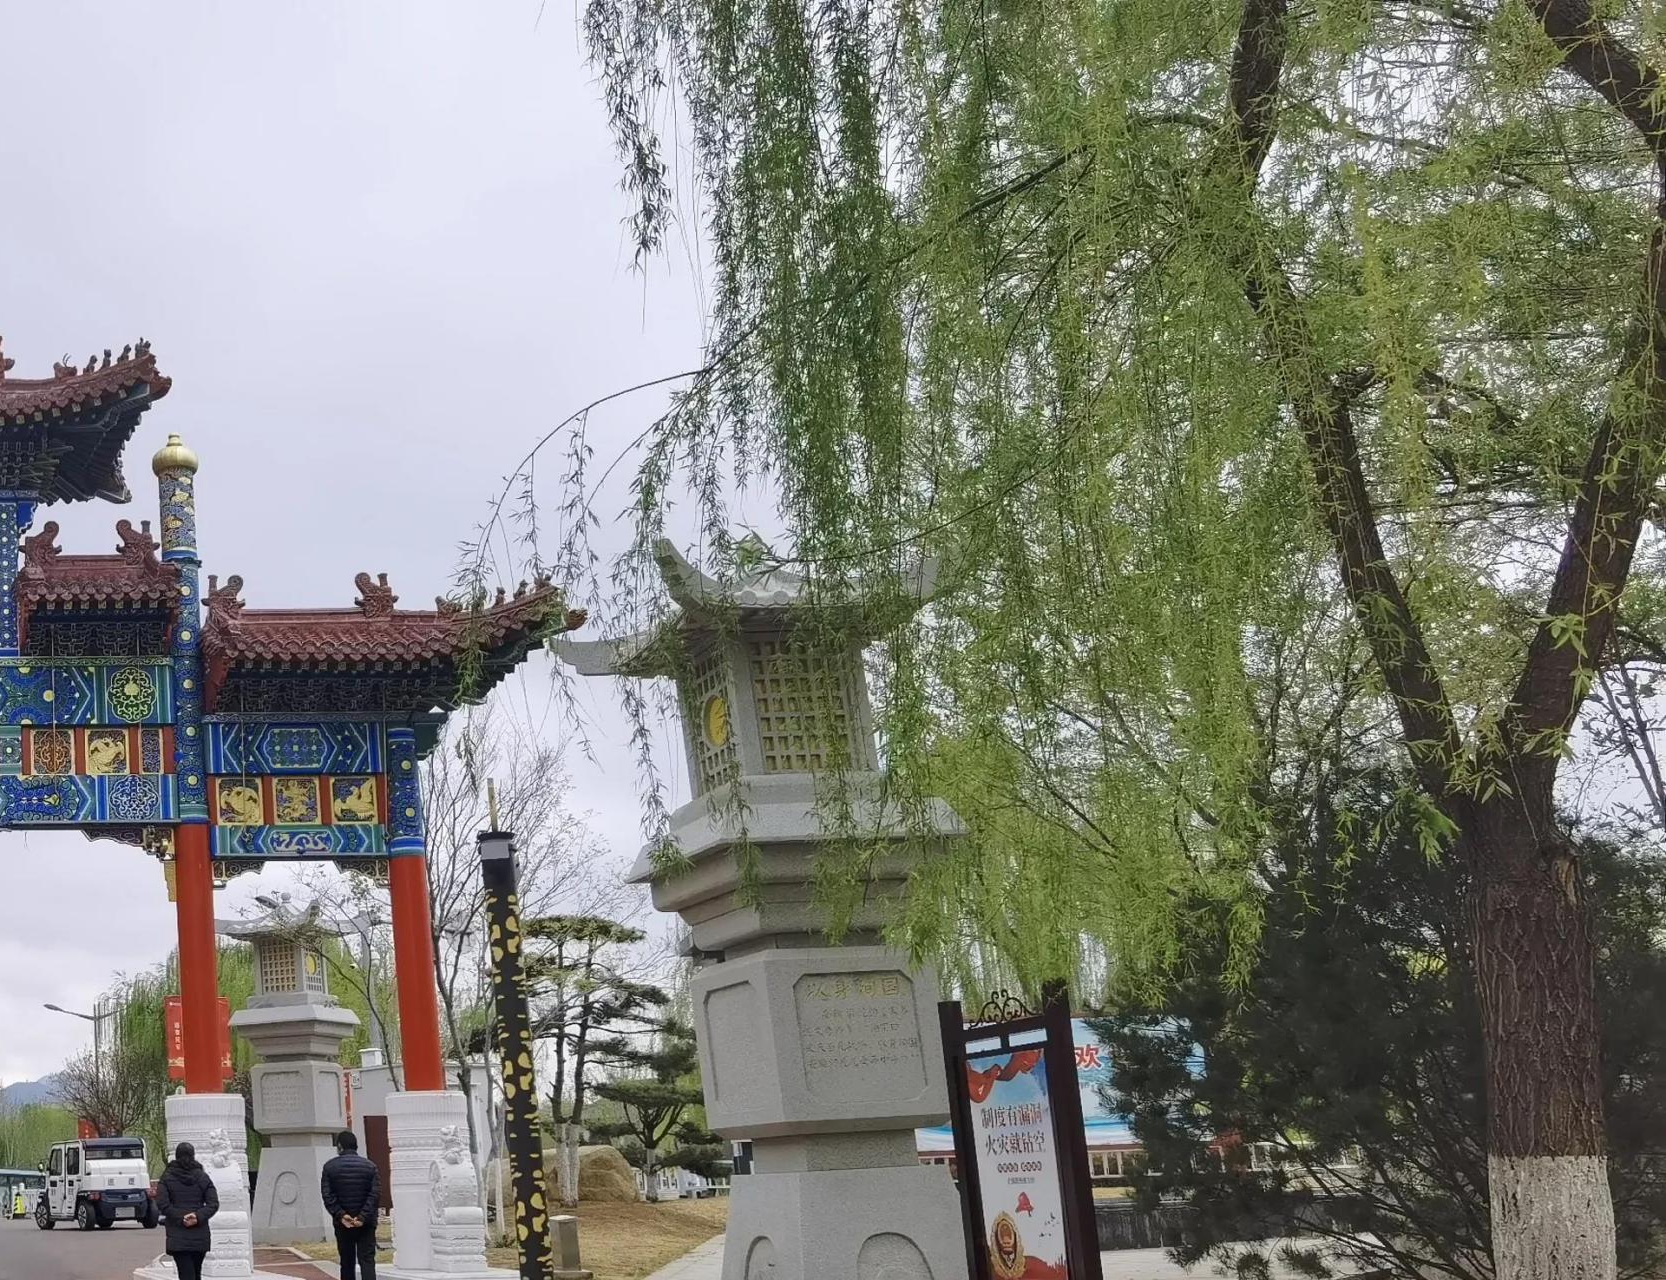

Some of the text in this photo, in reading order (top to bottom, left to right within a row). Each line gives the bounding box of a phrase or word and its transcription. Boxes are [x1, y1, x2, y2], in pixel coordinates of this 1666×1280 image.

[981, 1102, 1043, 1128] 制度有漏洞
